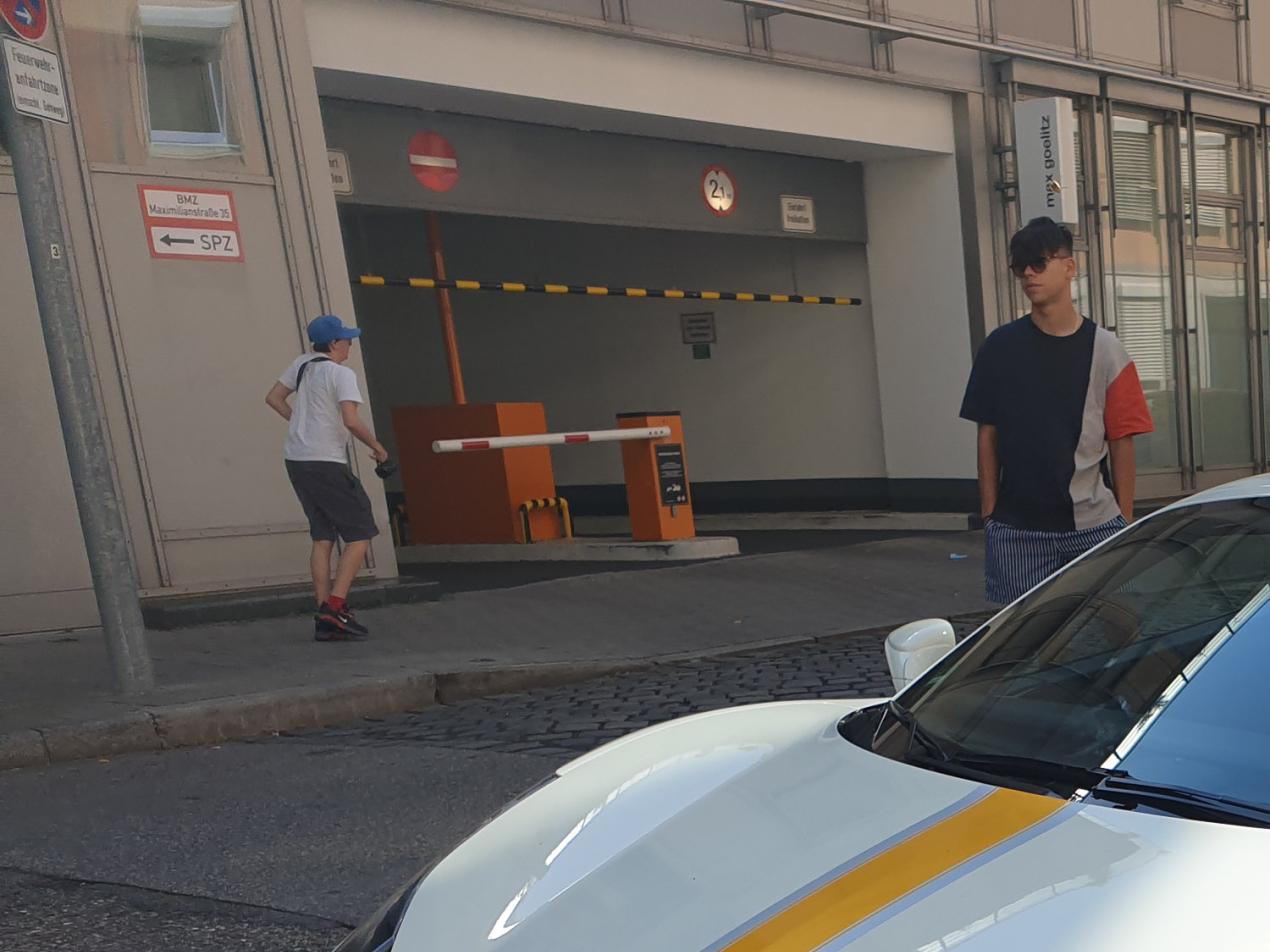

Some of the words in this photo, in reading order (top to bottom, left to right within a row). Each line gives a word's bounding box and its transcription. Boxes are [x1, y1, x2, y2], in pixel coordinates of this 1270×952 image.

[1040, 115, 1055, 169] goelitz
[176, 194, 199, 206] BMZ
[149, 203, 219, 218] Maximilianstraße
[219, 208, 230, 219] 35
[200, 234, 234, 252] SPZ
